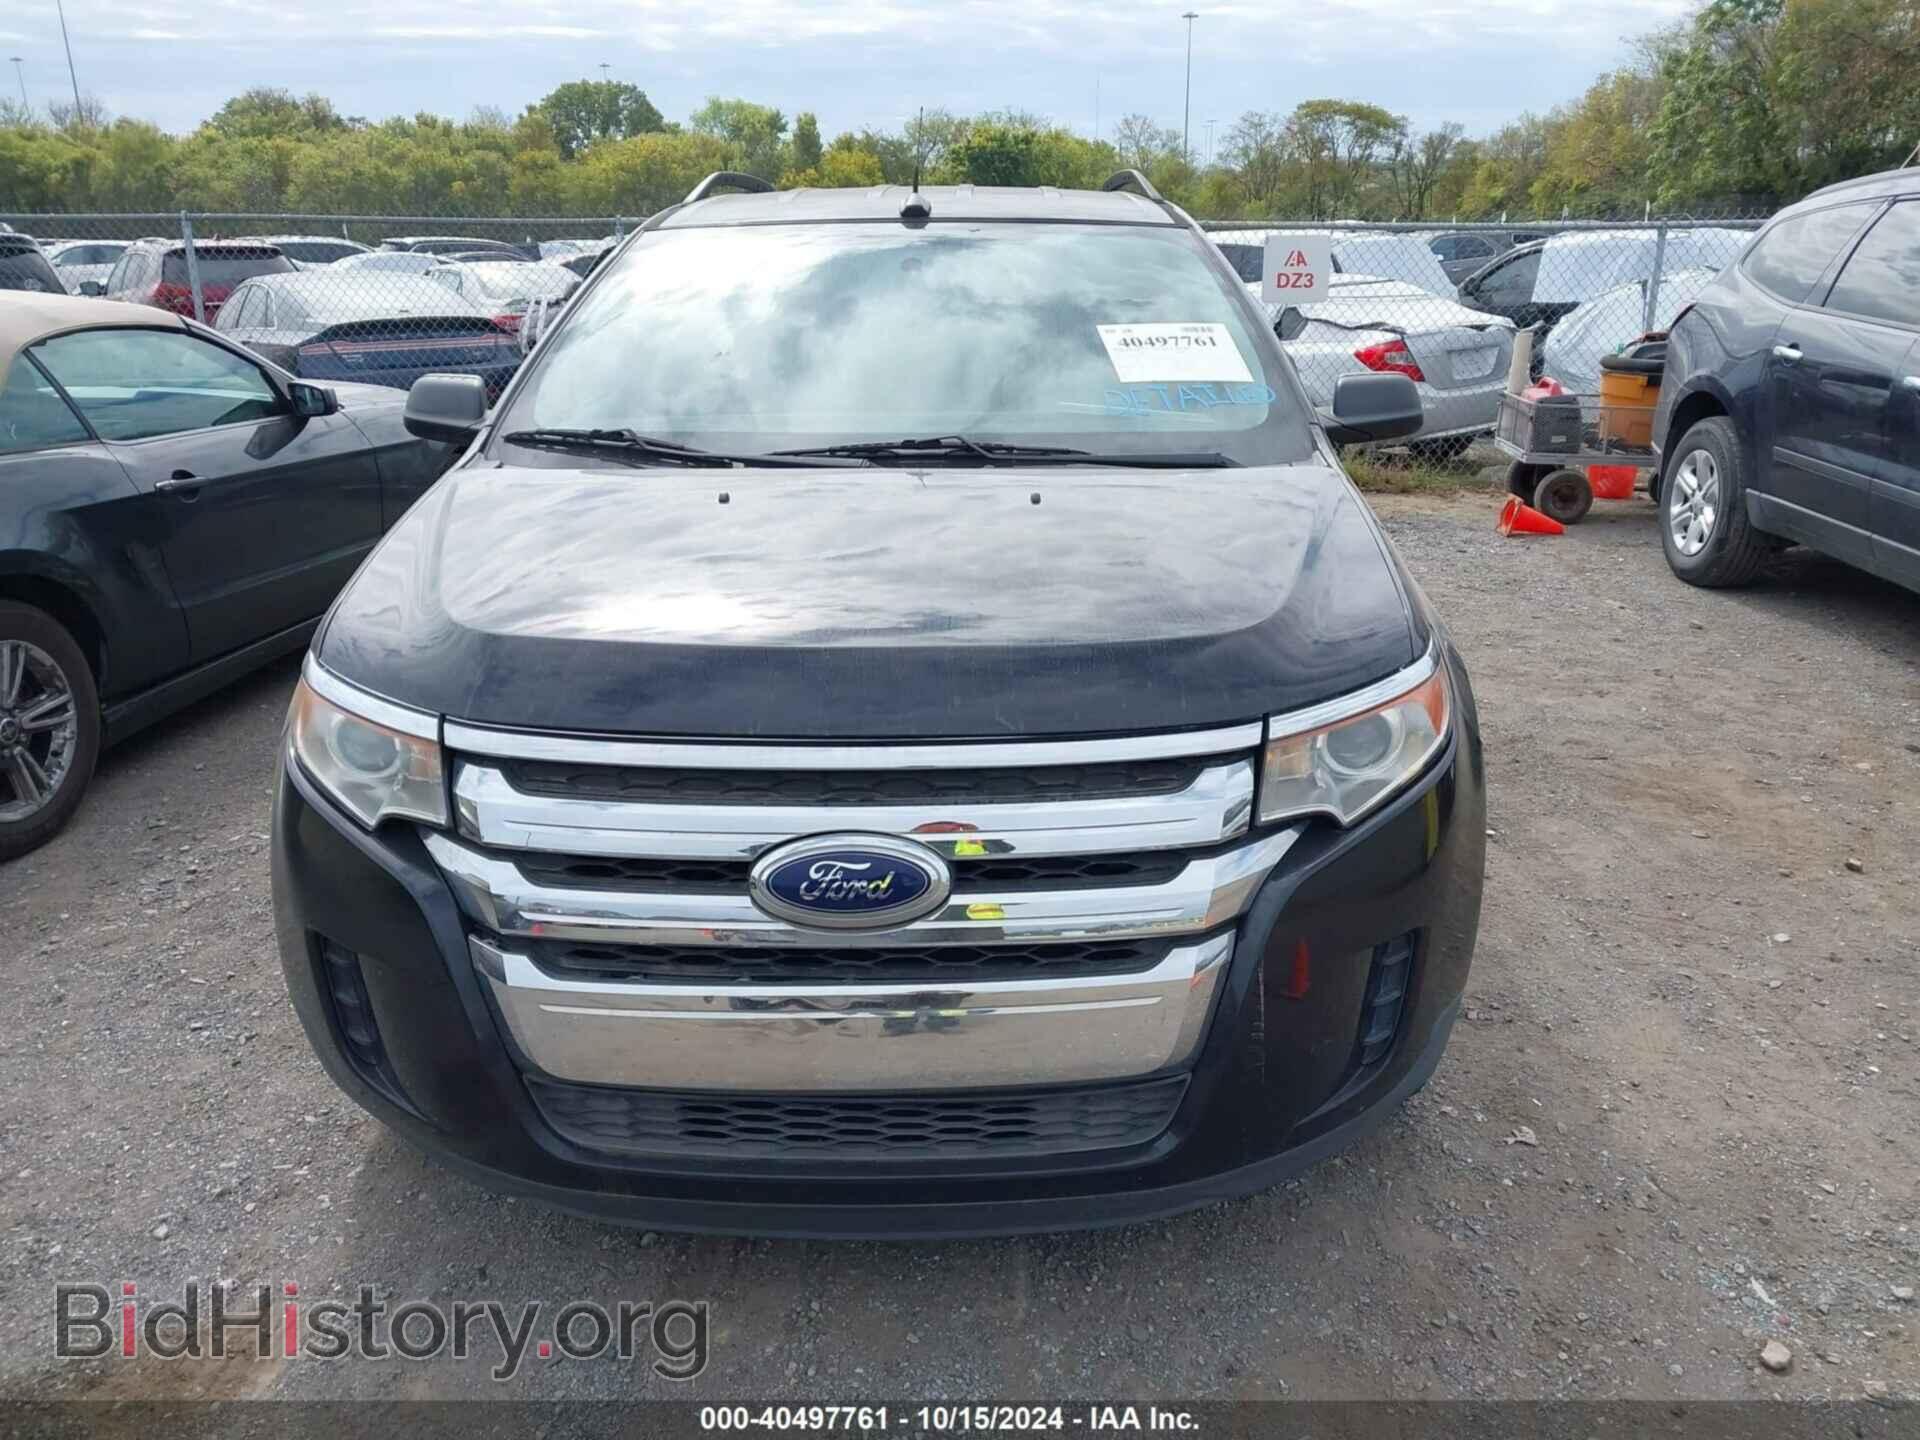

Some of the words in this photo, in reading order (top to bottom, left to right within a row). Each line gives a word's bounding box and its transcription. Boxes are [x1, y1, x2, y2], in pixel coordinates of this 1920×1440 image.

[1276, 272, 1315, 289] DZ3
[1117, 335, 1218, 348] 40497761
[799, 860, 895, 900] Ford
